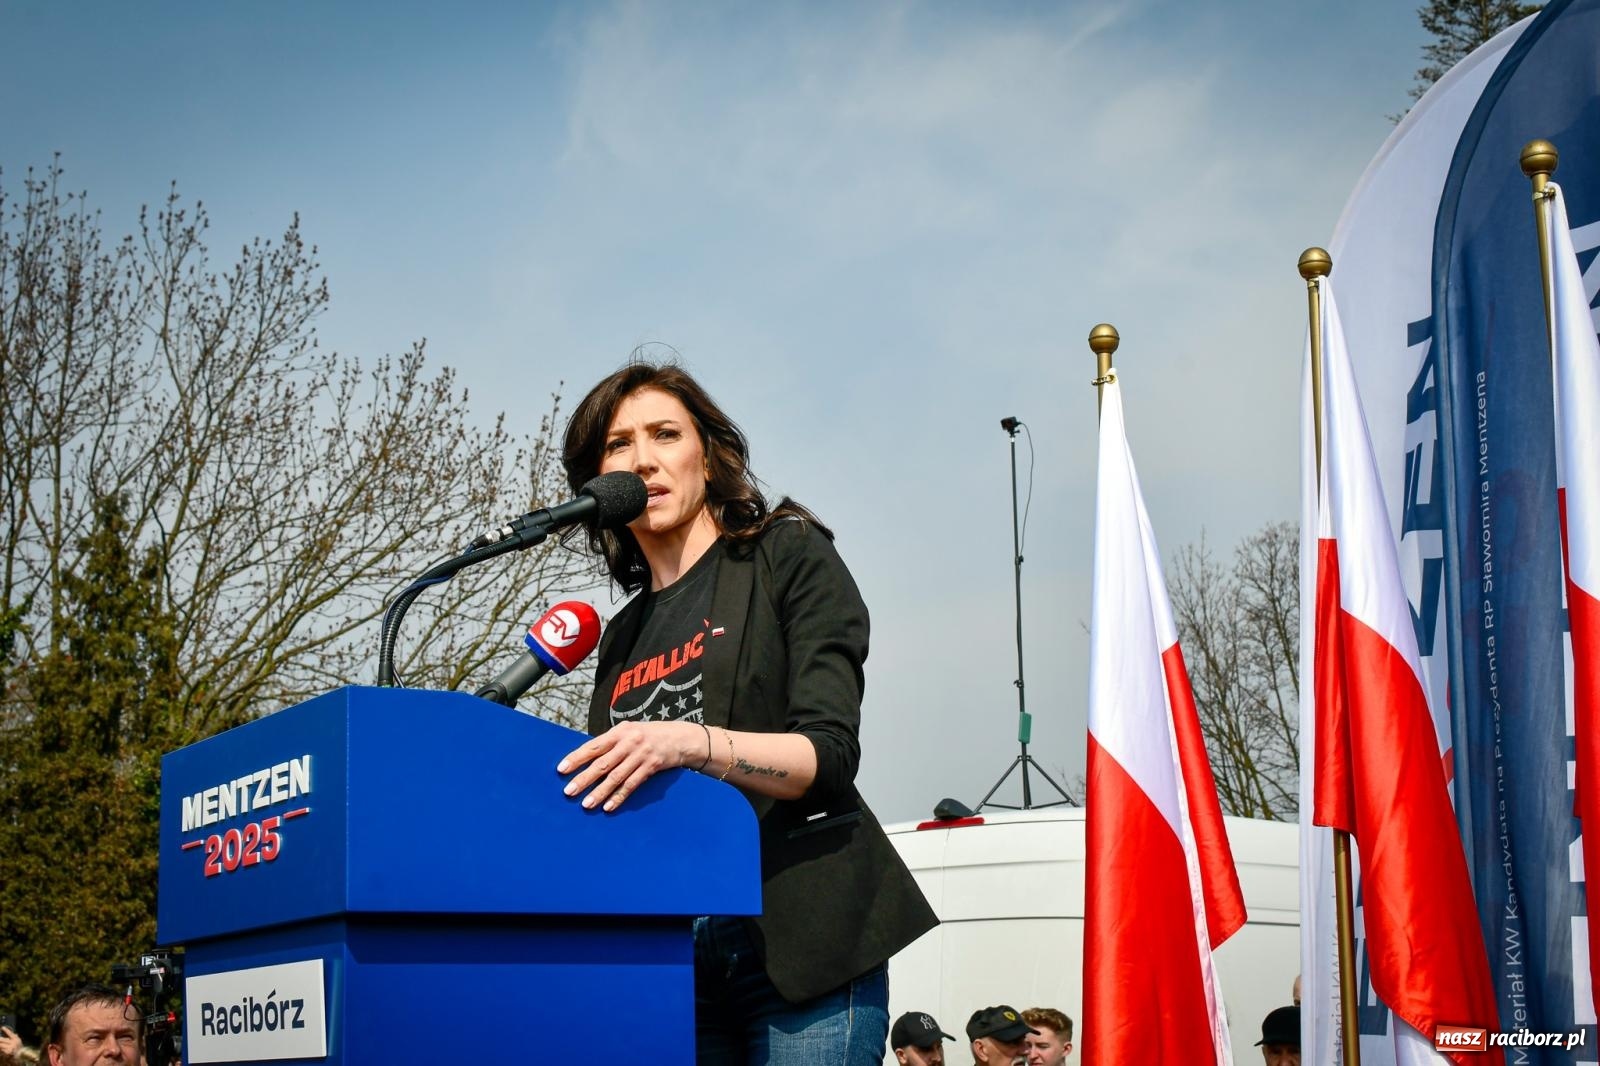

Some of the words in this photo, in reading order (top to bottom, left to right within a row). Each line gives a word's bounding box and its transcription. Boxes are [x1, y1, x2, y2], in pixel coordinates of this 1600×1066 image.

[1476, 371, 1489, 475] Mentzena
[1480, 480, 1493, 593] Sławomira
[1483, 600, 1494, 629] RP
[610, 618, 710, 709] ETALLIC
[181, 754, 311, 832] MENTZEN
[204, 815, 283, 876] 2025
[1505, 927, 1522, 966] KW
[201, 988, 305, 1036] Racibórz
[1506, 970, 1530, 1065] Mteriał
